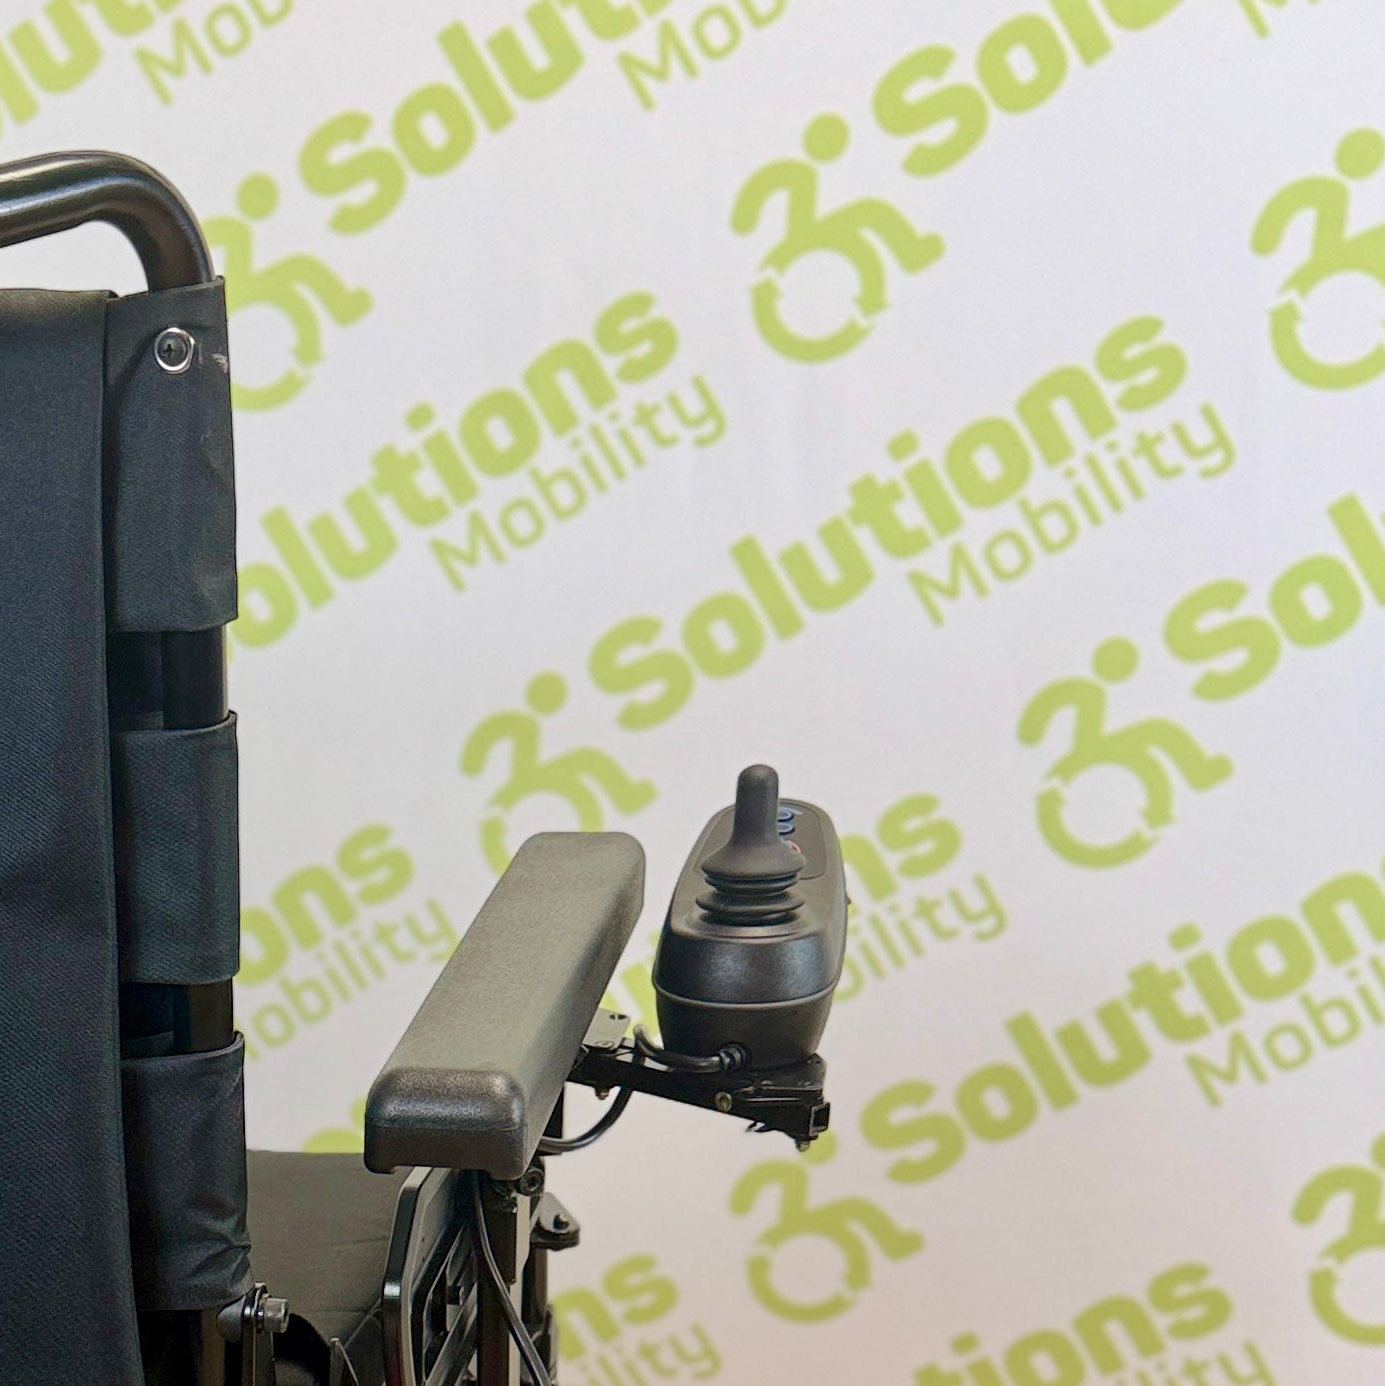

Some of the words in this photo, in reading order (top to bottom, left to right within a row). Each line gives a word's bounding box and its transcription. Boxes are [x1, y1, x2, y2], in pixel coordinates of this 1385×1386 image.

[225, 291, 680, 664] olutions
[430, 375, 728, 592] Mobility
[588, 315, 1189, 731] Solutions
[907, 403, 1237, 627] Mobility
[234, 899, 460, 1061] obility
[859, 851, 1385, 1186] Solution
